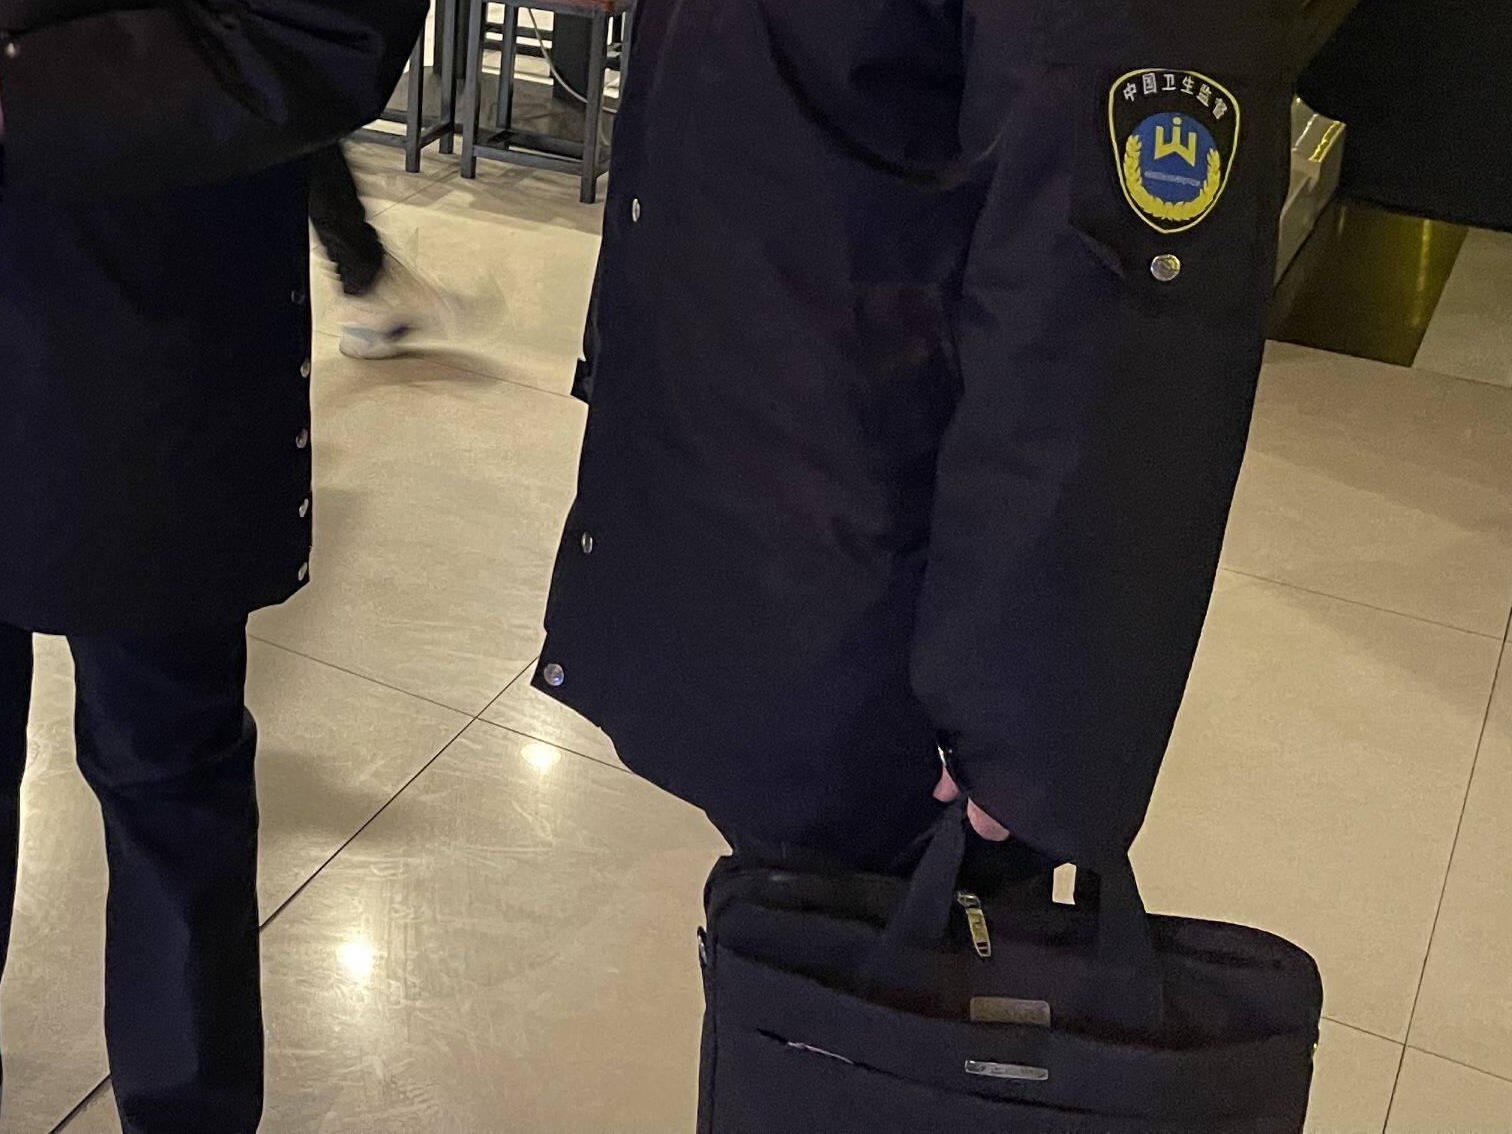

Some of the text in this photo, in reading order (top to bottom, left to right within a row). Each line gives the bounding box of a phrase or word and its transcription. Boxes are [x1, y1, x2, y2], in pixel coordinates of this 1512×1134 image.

[1123, 72, 1228, 120] 中国卫生监督
